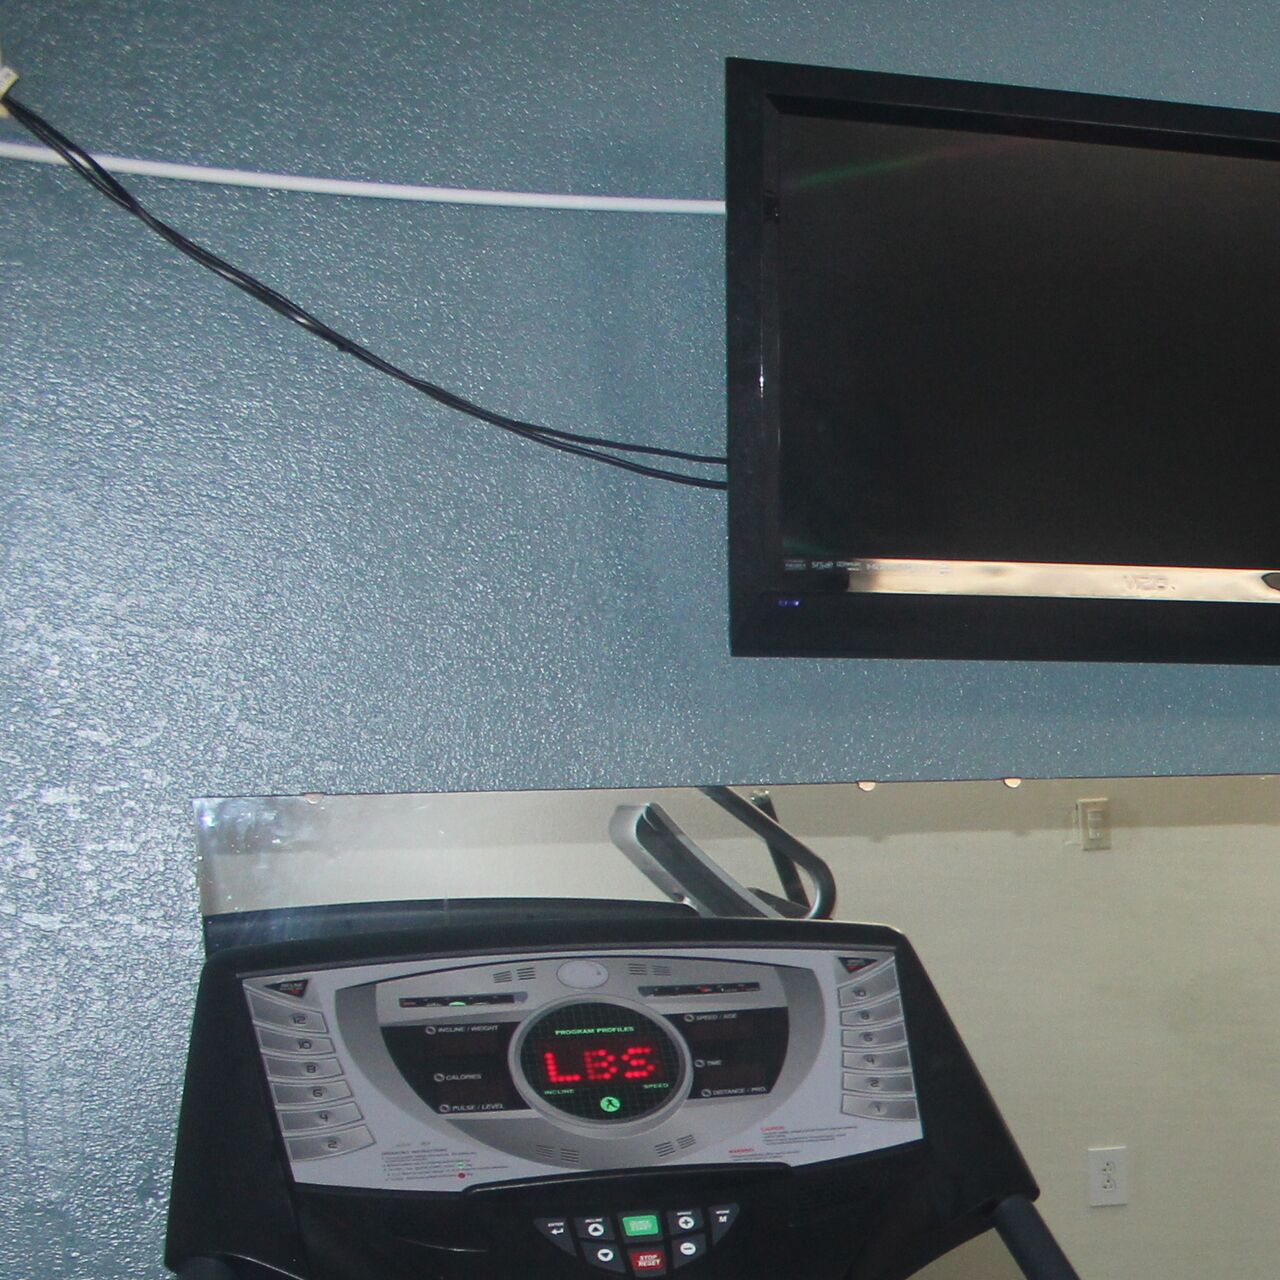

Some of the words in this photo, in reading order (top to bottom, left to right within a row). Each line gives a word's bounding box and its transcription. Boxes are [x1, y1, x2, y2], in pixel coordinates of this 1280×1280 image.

[292, 1015, 306, 1025] 12
[554, 1028, 595, 1036] PROGRAM
[596, 1026, 635, 1034] PROFILES
[299, 1040, 313, 1050] 10
[543, 1046, 656, 1083] LBS
[713, 1088, 745, 1096] DISTANCE
[328, 1140, 338, 1149] 2
[718, 1215, 727, 1223] M
[638, 1259, 661, 1267] RESET
